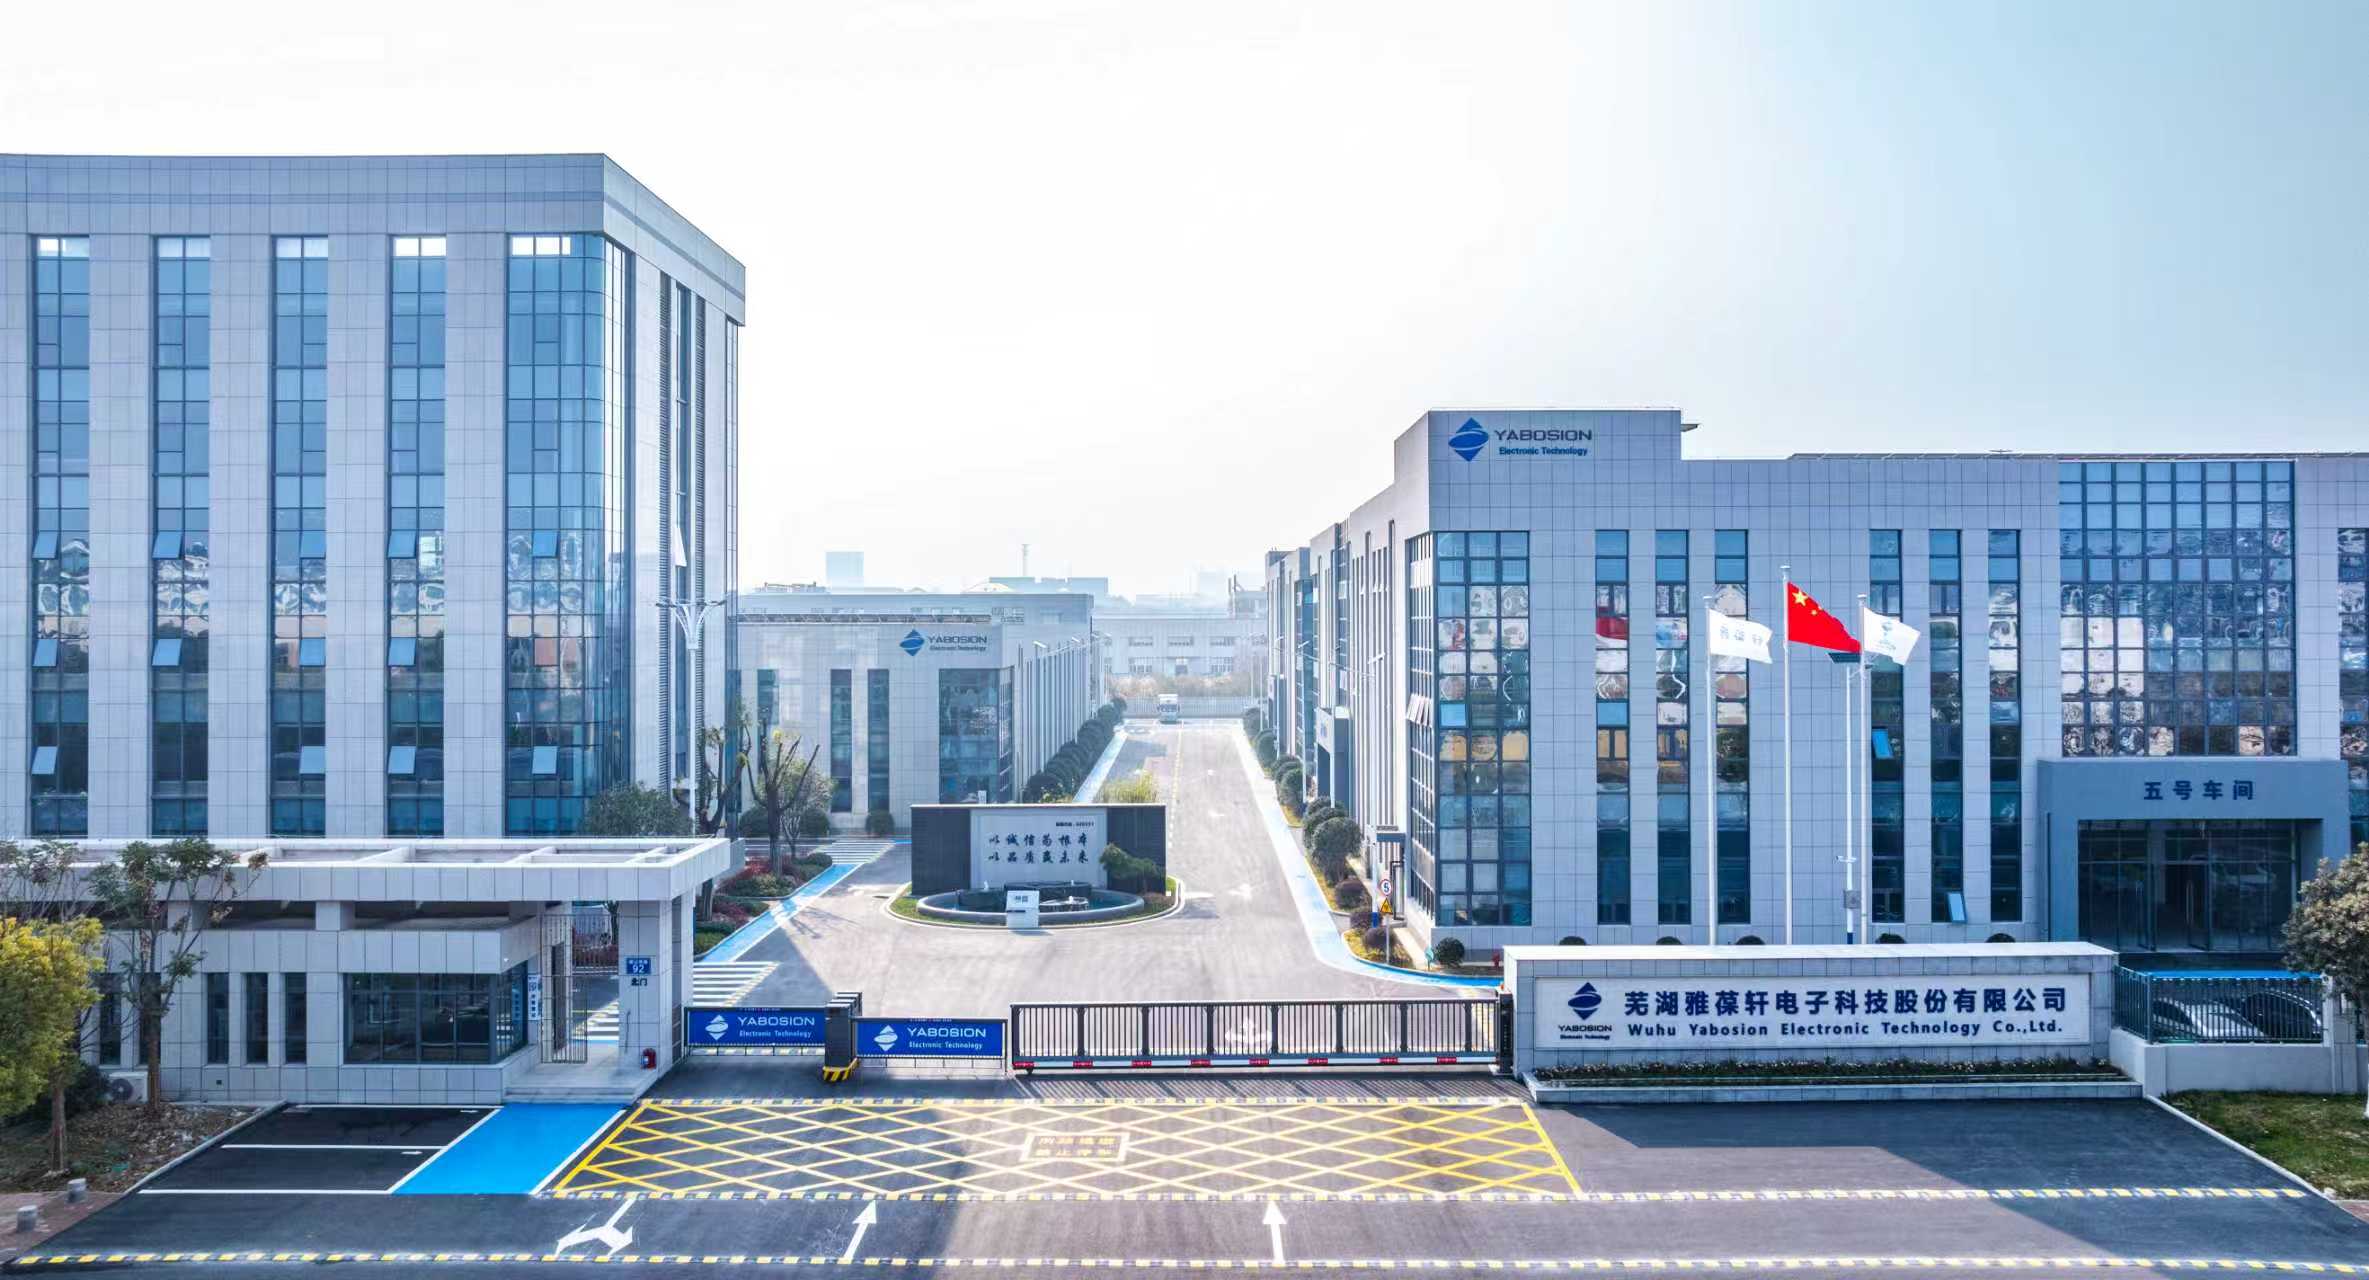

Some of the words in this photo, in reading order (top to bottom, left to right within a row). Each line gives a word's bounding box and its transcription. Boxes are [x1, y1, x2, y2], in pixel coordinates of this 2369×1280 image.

[1494, 429, 1592, 441] YABOSION
[1499, 446, 1539, 455] Electronic
[1542, 446, 1587, 456] Technology
[928, 635, 987, 643] YABOSION
[2144, 780, 2253, 800] 五号车间
[632, 964, 645, 974] 92
[631, 977, 648, 986] 北门
[1624, 987, 2066, 1017] 芜湖雅葆轩电子科技股份有限公司
[738, 1016, 815, 1026] YABOSION
[907, 1027, 986, 1037] YABOSION
[1628, 1023, 1676, 1036] Wuhu
[1689, 1023, 1768, 1036] Yabosion
[1781, 1022, 1869, 1035] Electronic
[1882, 1020, 1980, 1036] Technology
[1993, 1019, 2062, 1034] Co.,Ltd.
[774, 1030, 812, 1038] Technology
[945, 1041, 982, 1049] Technology
